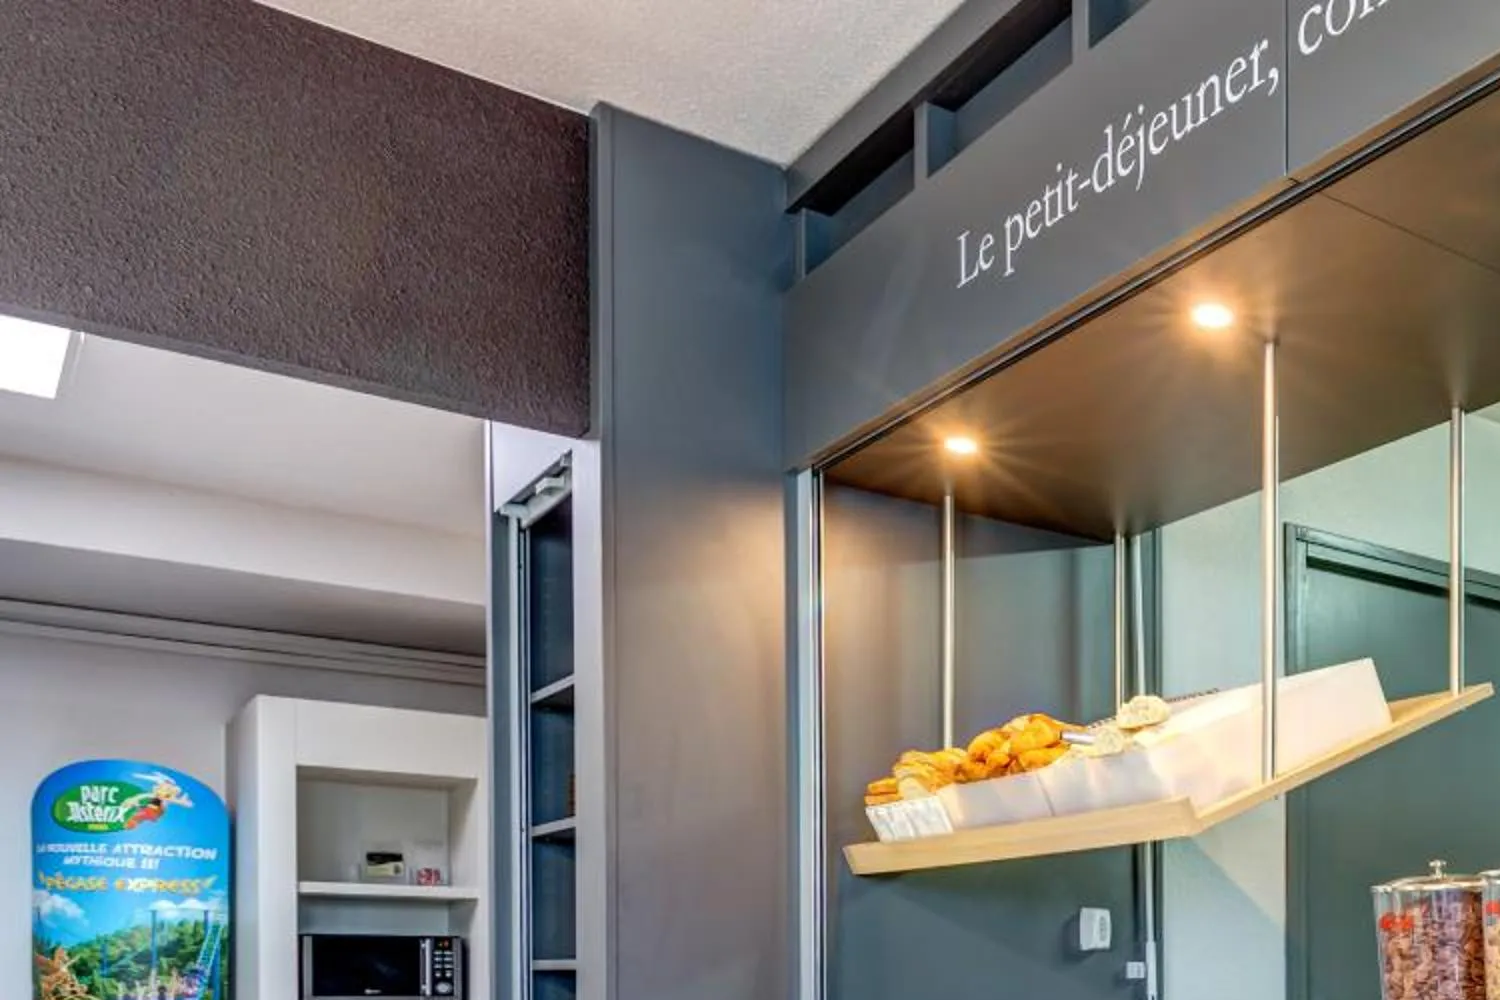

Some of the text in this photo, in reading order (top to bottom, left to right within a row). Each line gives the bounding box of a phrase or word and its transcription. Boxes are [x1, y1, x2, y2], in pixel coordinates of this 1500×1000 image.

[955, 230, 995, 288] Le
[1002, 38, 1280, 277] petit-déjeuner,
[111, 843, 218, 861] ATTRACTION
